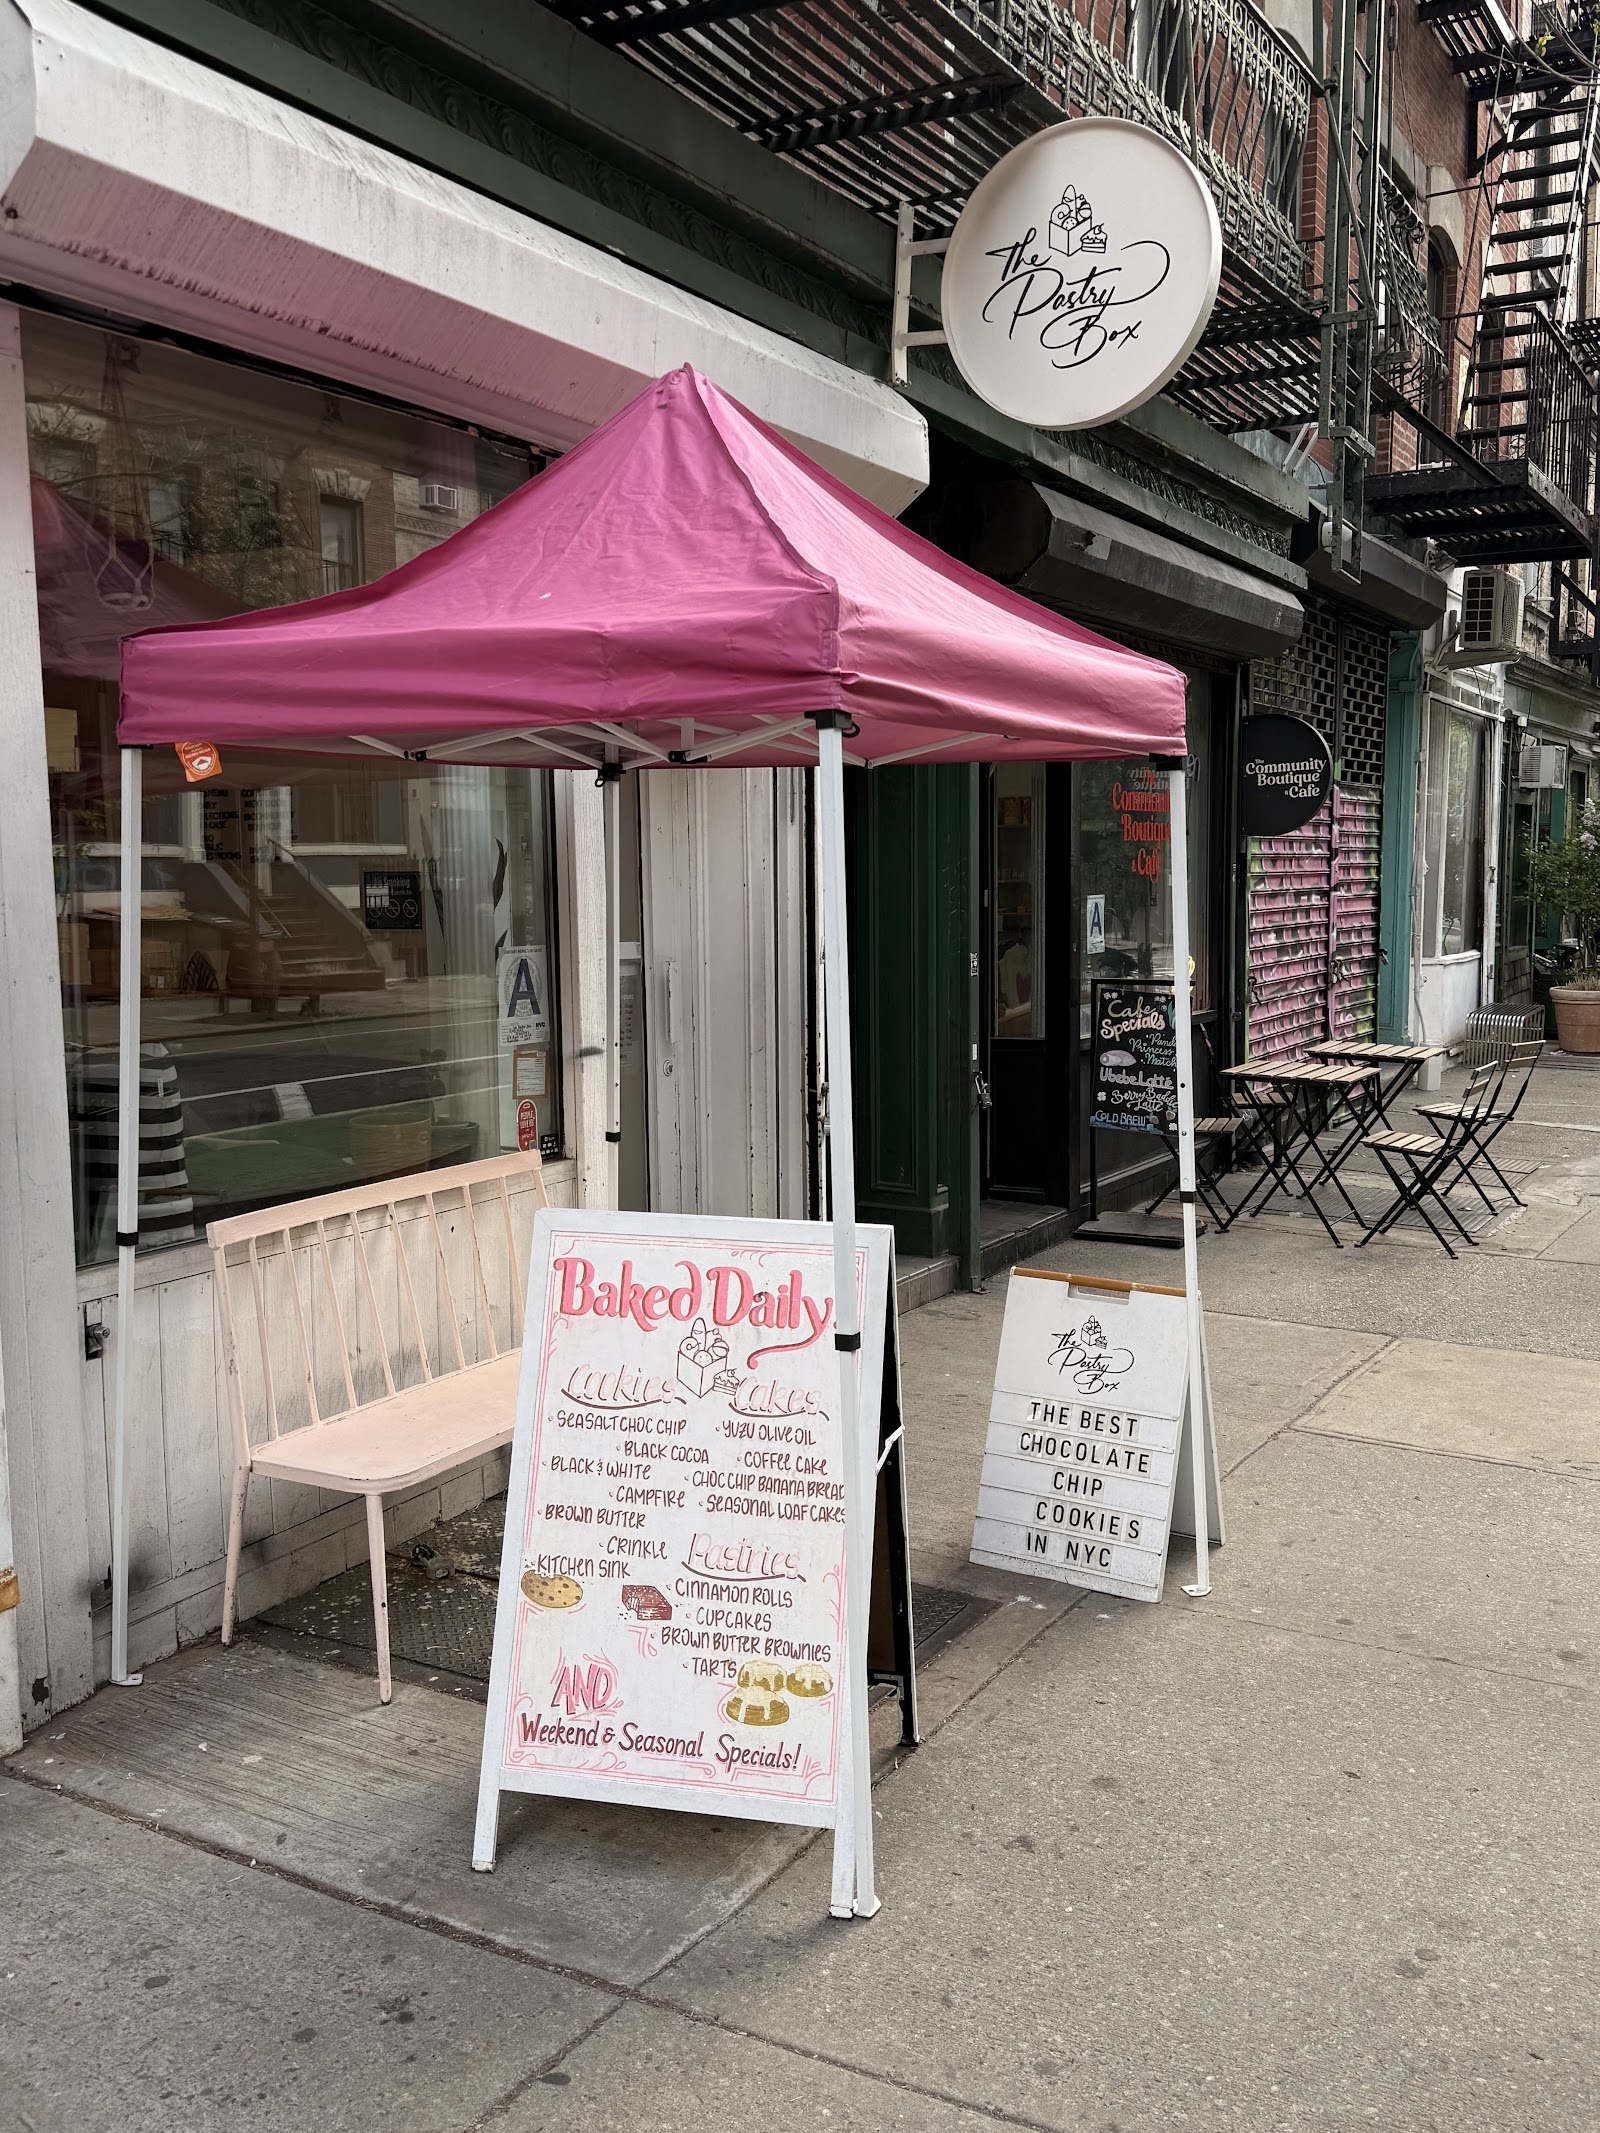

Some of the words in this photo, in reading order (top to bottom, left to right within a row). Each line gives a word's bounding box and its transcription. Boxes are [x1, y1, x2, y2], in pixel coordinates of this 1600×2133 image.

[985, 227, 1052, 281] The
[982, 240, 1171, 340] Pastry
[1040, 306, 1142, 369] Box
[1245, 757, 1327, 775] Community
[1257, 771, 1320, 787] Boutique
[1288, 783, 1321, 799] Cafe
[1121, 813, 1171, 849] Boutiqu
[384, 877, 410, 888] Smoking
[1090, 902, 1102, 938] A
[507, 958, 541, 1018] A
[1108, 996, 1156, 1018] Cafe
[1100, 1012, 1166, 1041] Specials
[1145, 1053, 1177, 1067] Match
[1111, 1090, 1146, 1105] Berry
[1127, 1099, 1163, 1112] Latte
[1120, 1112, 1146, 1127] BREW
[553, 1256, 702, 1332] Baked
[1051, 1329, 1081, 1350] The
[1047, 1347, 1135, 1376] Pastry
[568, 1363, 677, 1404] Cookies
[734, 1376, 823, 1414] Cakes
[1073, 1370, 1120, 1394] Box
[619, 1416, 653, 1434] CHOC
[656, 1418, 687, 1436] CHIP
[722, 1419, 755, 1439] YUZU
[758, 1424, 794, 1443] OLIVE
[794, 1428, 816, 1446] OIL
[1030, 1401, 1070, 1426] THE
[1080, 1410, 1138, 1437] BEST
[624, 1440, 668, 1459] BLACK
[670, 1445, 709, 1464] COCOA
[744, 1450, 791, 1471] COFFEE
[795, 1455, 828, 1476] CAKE
[1020, 1432, 1149, 1474] CHOCOLATE
[551, 1455, 595, 1475] BLACK
[606, 1460, 651, 1480] WHITE
[616, 1485, 686, 1508] CAMPFIRE
[692, 1470, 726, 1488] CHOC
[727, 1473, 756, 1491] CHIP
[758, 1475, 805, 1497] BANANA
[1053, 1471, 1102, 1497] CHIP
[545, 1503, 593, 1524] BROWN
[596, 1508, 646, 1529] BUTTER
[706, 1494, 775, 1518] SEASONAL
[777, 1502, 810, 1521] LOAF
[1036, 1501, 1140, 1540] COOKIES
[606, 1535, 668, 1560] CRINKLE
[688, 1532, 801, 1579] Pastries
[1027, 1532, 1047, 1554] IN
[1066, 1543, 1111, 1568] NYC
[537, 1553, 594, 1578] KITCHEN
[598, 1559, 631, 1579] SINK
[675, 1577, 749, 1603] CINNAMON
[752, 1587, 793, 1608] ROLLS
[696, 1606, 772, 1632] CUPCAKES
[661, 1626, 710, 1649] BROWN
[712, 1632, 760, 1654] BUTTER
[764, 1639, 831, 1662] BROWNIES
[692, 1656, 737, 1679] TARTS
[551, 1662, 613, 1715] AND
[521, 1712, 600, 1748] Weekend
[602, 1725, 616, 1745] &
[618, 1721, 704, 1758] Seasonal
[714, 1733, 802, 1773] Specials!
